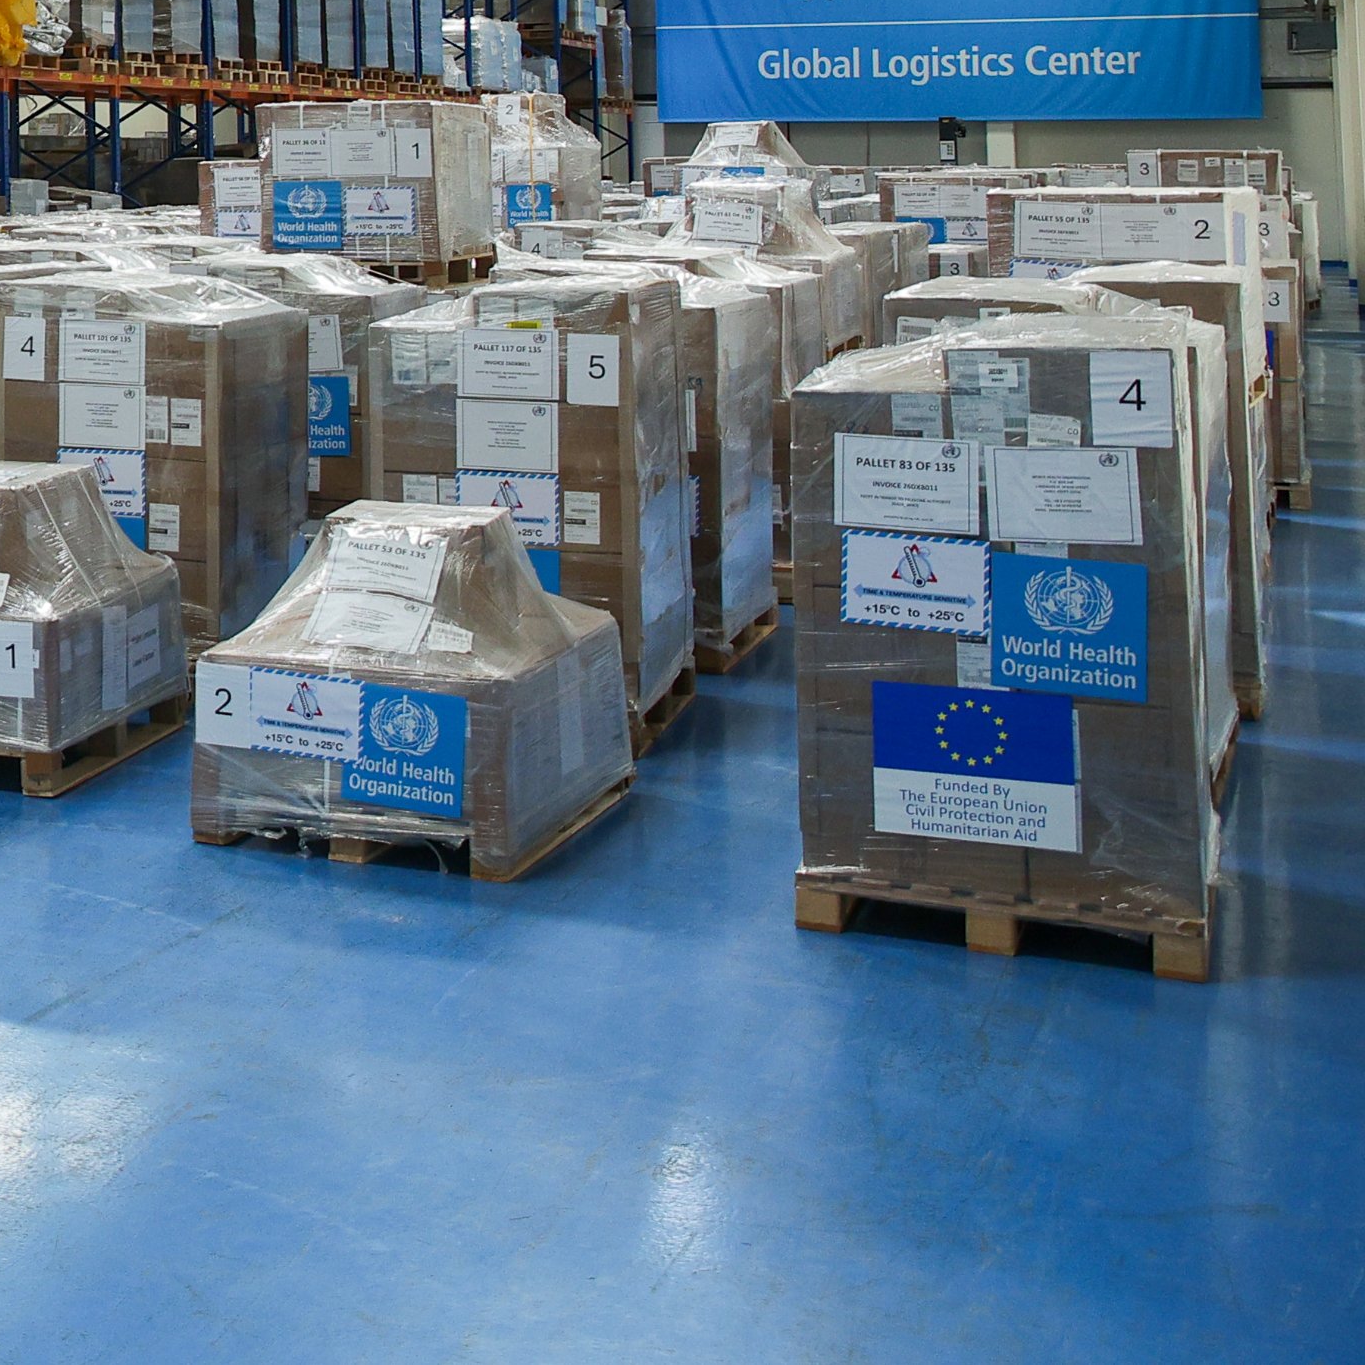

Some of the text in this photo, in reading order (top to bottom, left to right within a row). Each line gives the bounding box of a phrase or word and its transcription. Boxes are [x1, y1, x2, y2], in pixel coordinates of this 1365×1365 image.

[758, 45, 1141, 86] Global Logistics Center
[506, 105, 513, 115] 2
[412, 143, 419, 159] 1
[1139, 163, 1150, 175] 3
[278, 222, 337, 232] World Health
[1194, 220, 1210, 239] 2
[1259, 223, 1269, 236] 3
[277, 234, 337, 244] Organization
[531, 243, 541, 254] 4
[950, 263, 960, 275] 3
[1268, 292, 1280, 306] 3
[21, 336, 35, 356] 4
[588, 355, 606, 379] 5
[1118, 378, 1146, 411] 4
[311, 424, 344, 436] Health
[856, 457, 955, 472] PALLET 83 OF 135
[109, 499, 131, 508] +25°C
[348, 541, 426, 559] PALLET 53 OF 135
[886, 591, 932, 601] TEMPERATURE
[865, 604, 964, 622] +15°C to +25°C
[5, 644, 16, 668] 1
[1001, 635, 1136, 666] World Health
[1001, 659, 1136, 689] Organization
[215, 688, 233, 716] 2
[282, 722, 318, 732] TEMPERATURE
[265, 734, 343, 751] +15°C to +25°C
[352, 755, 454, 785] World Health
[349, 774, 454, 805] Organization
[935, 779, 1010, 798] Funded By
[900, 789, 1047, 814] The European Union
[906, 804, 1046, 828] Civil Protection and
[911, 819, 1037, 841] Humanitarian Aid
